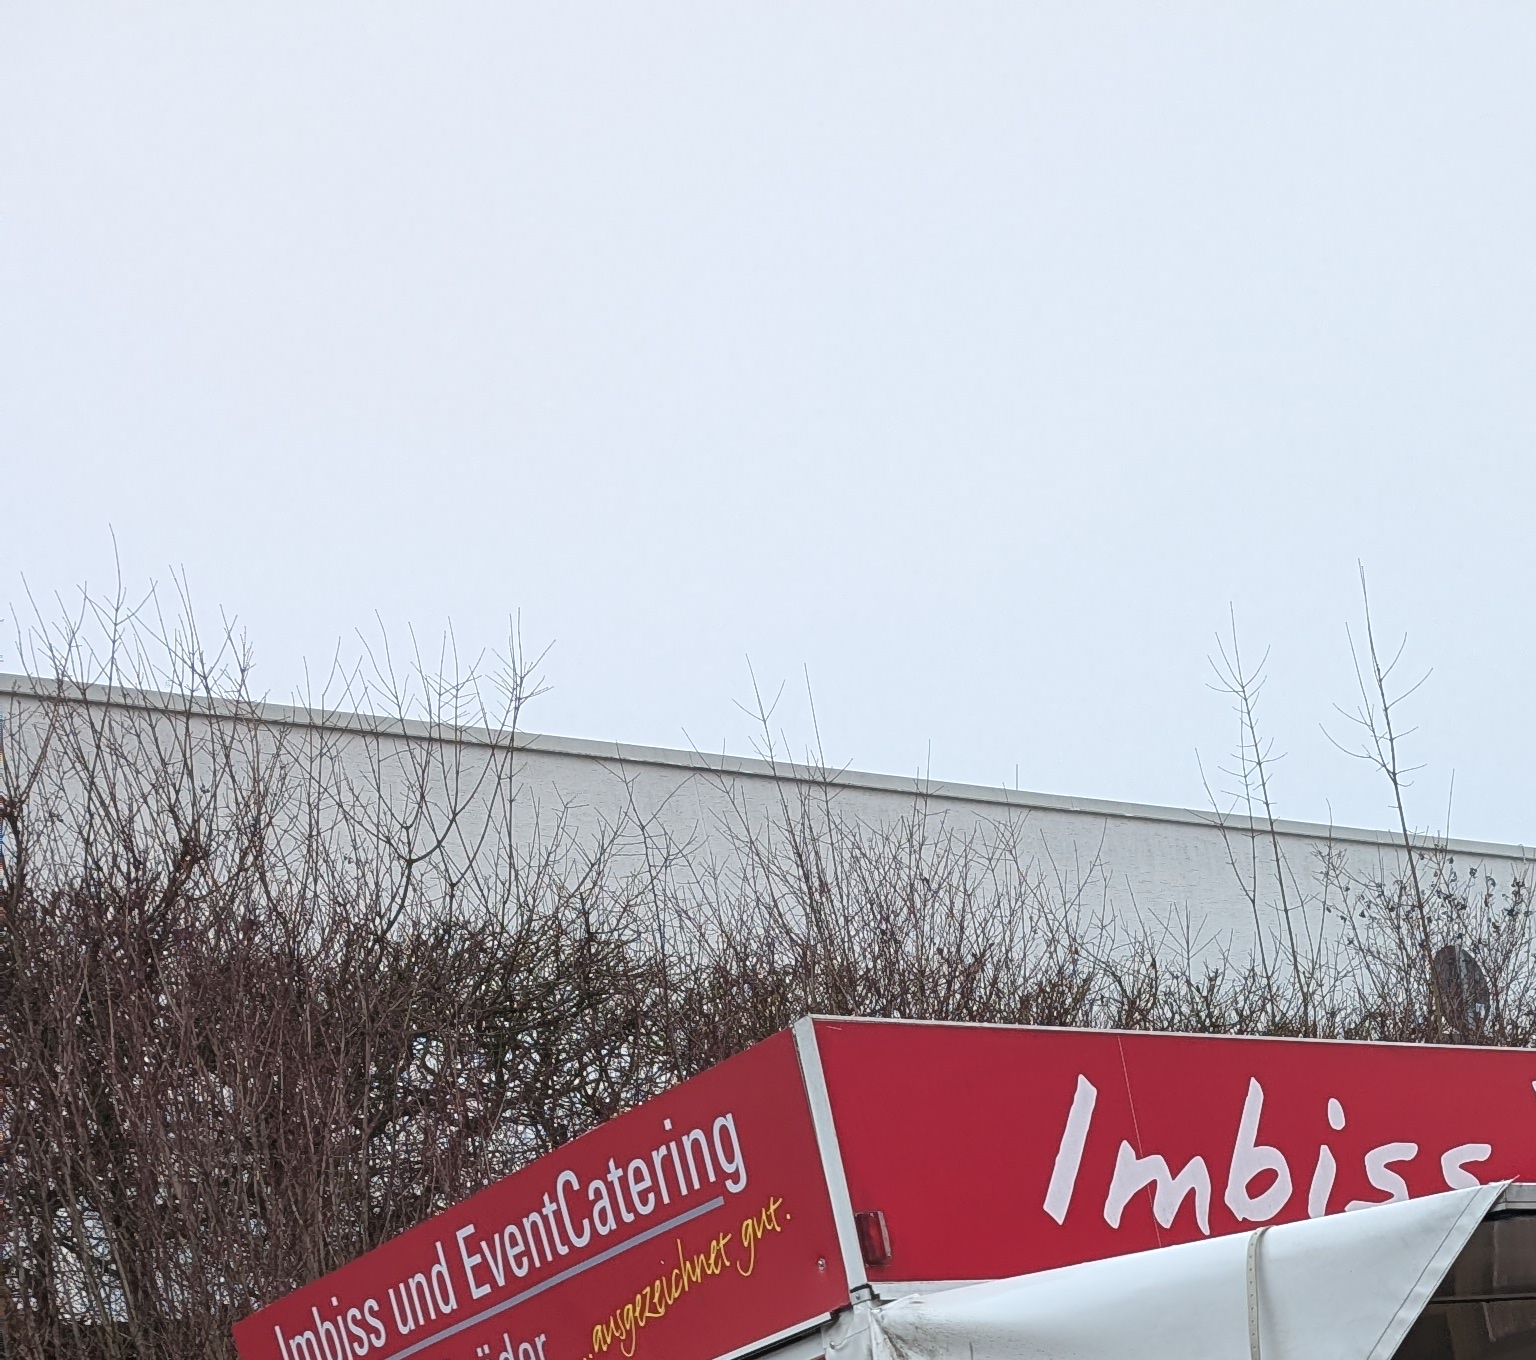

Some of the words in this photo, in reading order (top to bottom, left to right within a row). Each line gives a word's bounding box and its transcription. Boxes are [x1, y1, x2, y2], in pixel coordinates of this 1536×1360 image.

[388, 1240, 457, 1335] und
[457, 1111, 748, 1302] EventCatering
[1043, 1074, 1491, 1234] Imbiss
[736, 1197, 792, 1276] gut.
